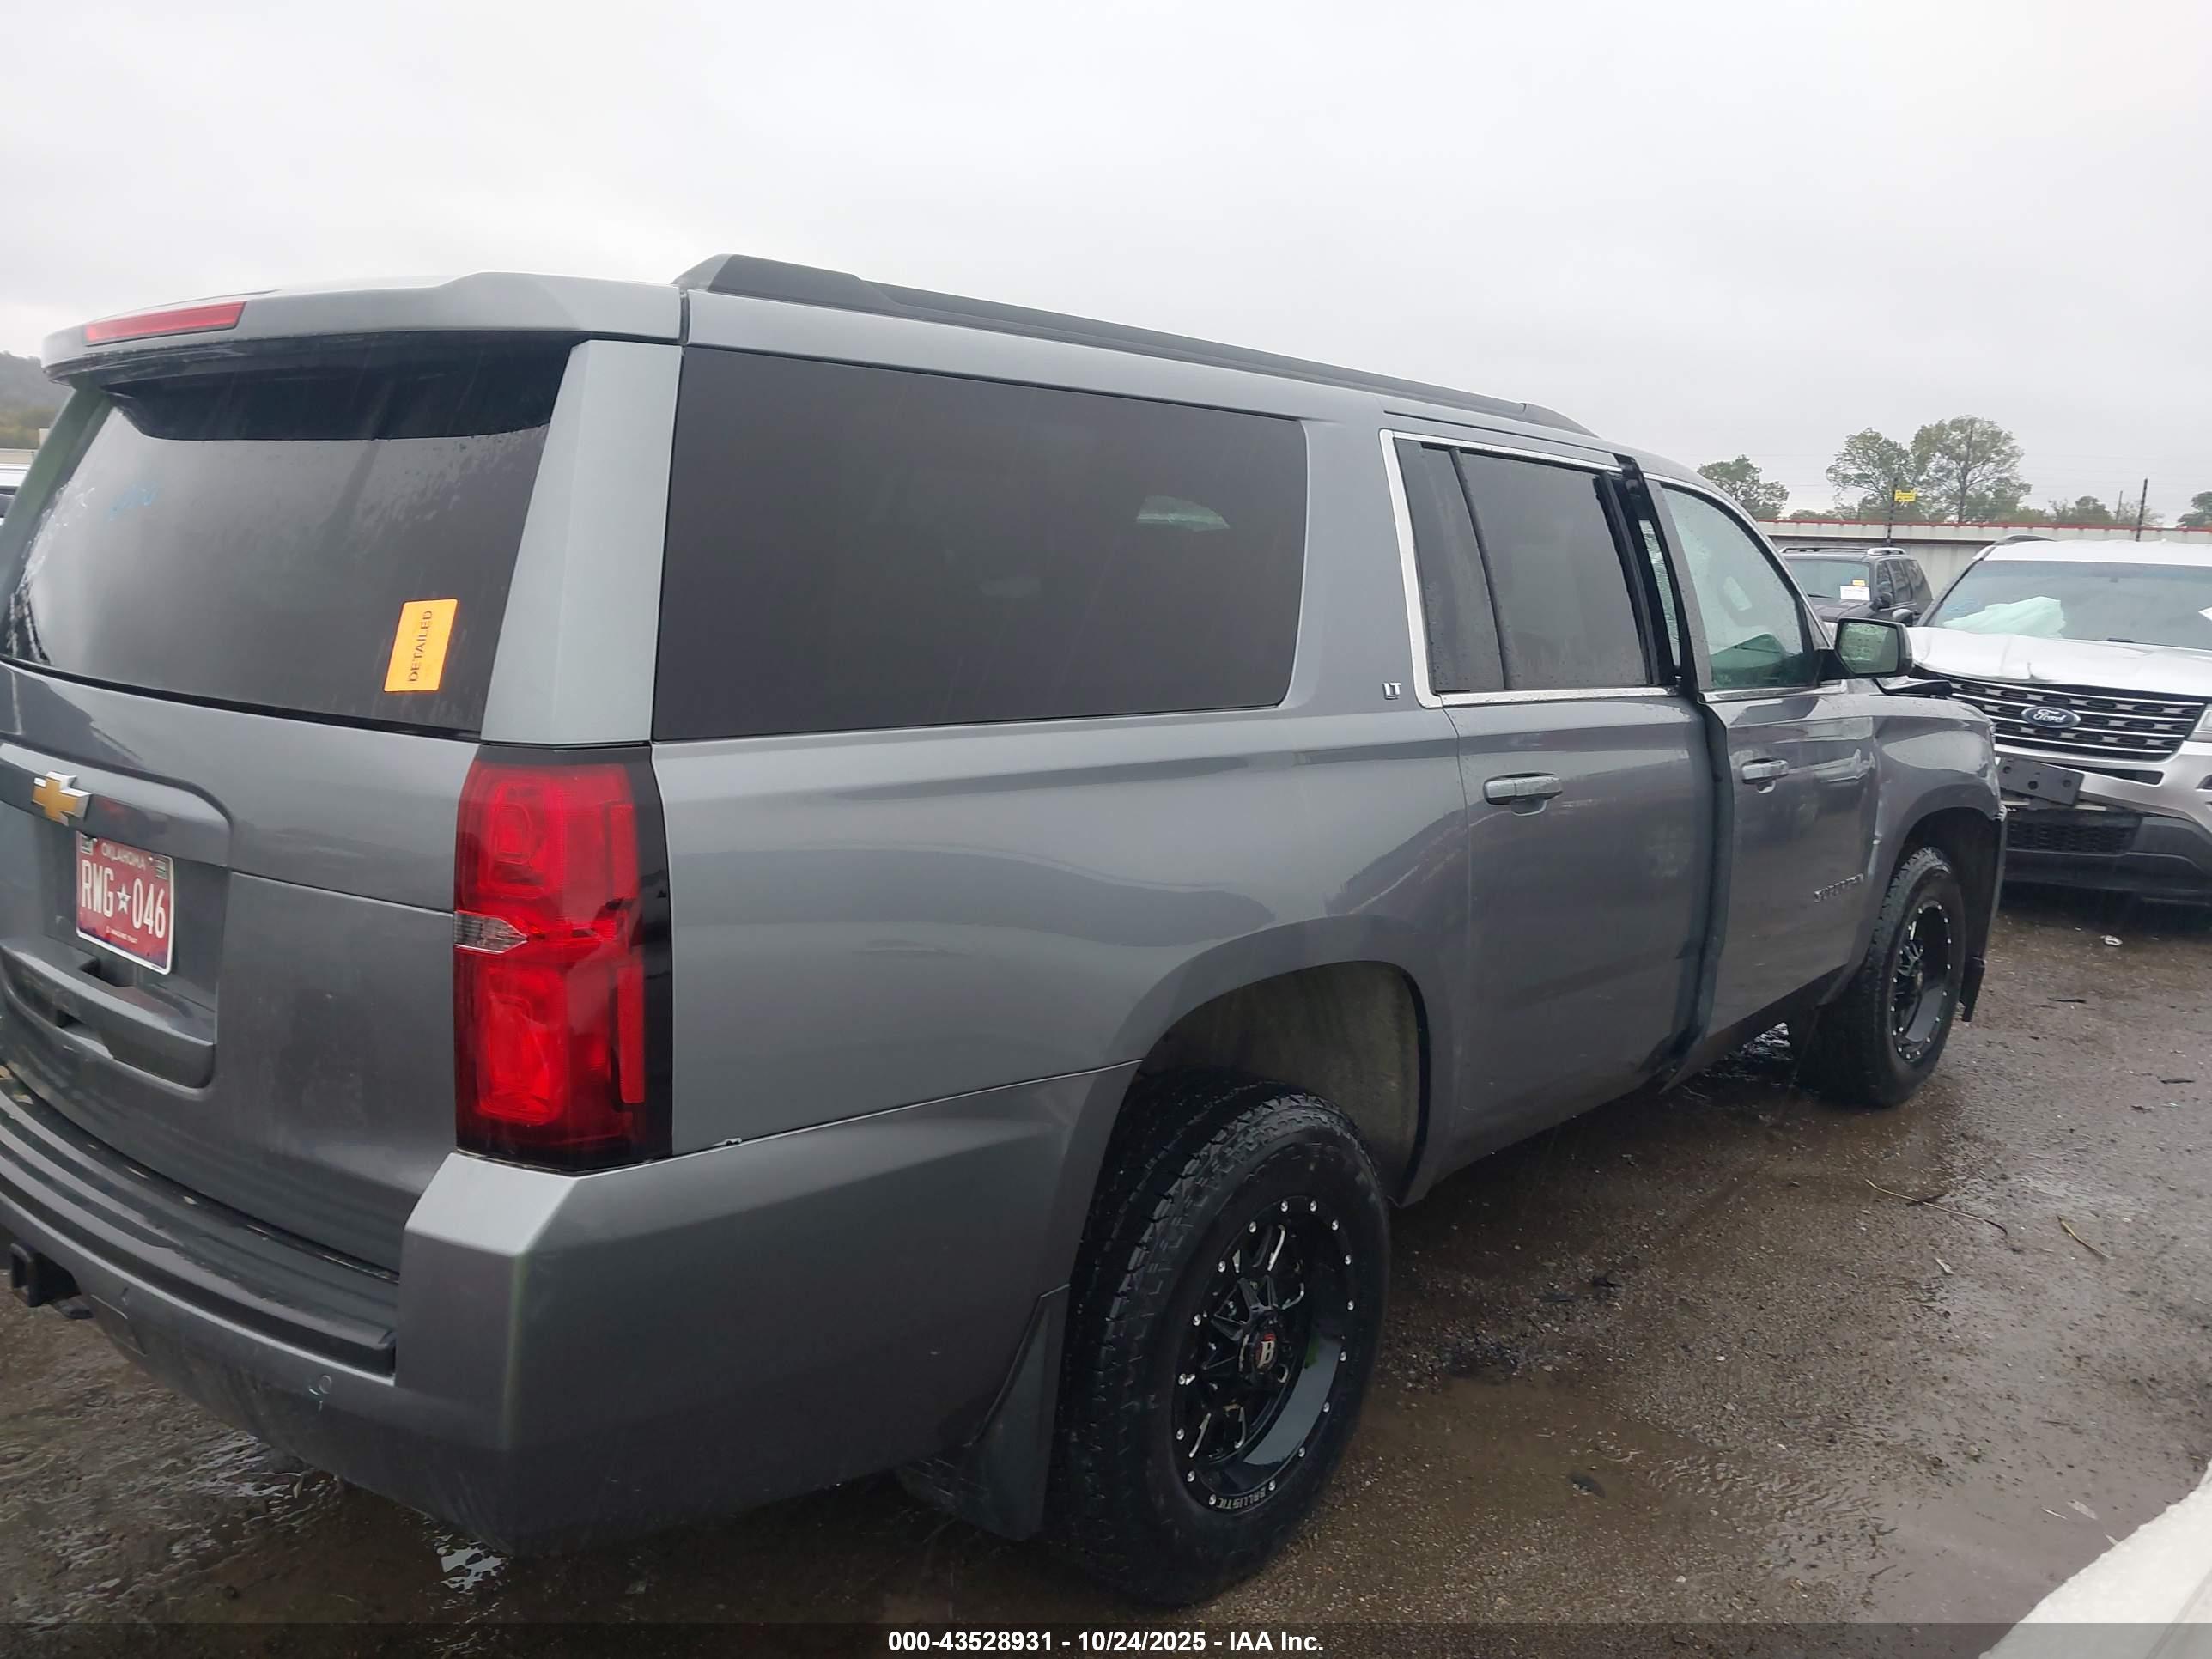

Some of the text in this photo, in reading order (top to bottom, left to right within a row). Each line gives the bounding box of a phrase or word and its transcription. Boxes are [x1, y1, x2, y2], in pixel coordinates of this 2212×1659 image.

[407, 611, 433, 682] DETAILED
[1382, 682, 1402, 700] LT
[2033, 709, 2067, 723] Ford
[82, 860, 166, 939] RWG 046
[1216, 1486, 1267, 1510] BALLISTIC
